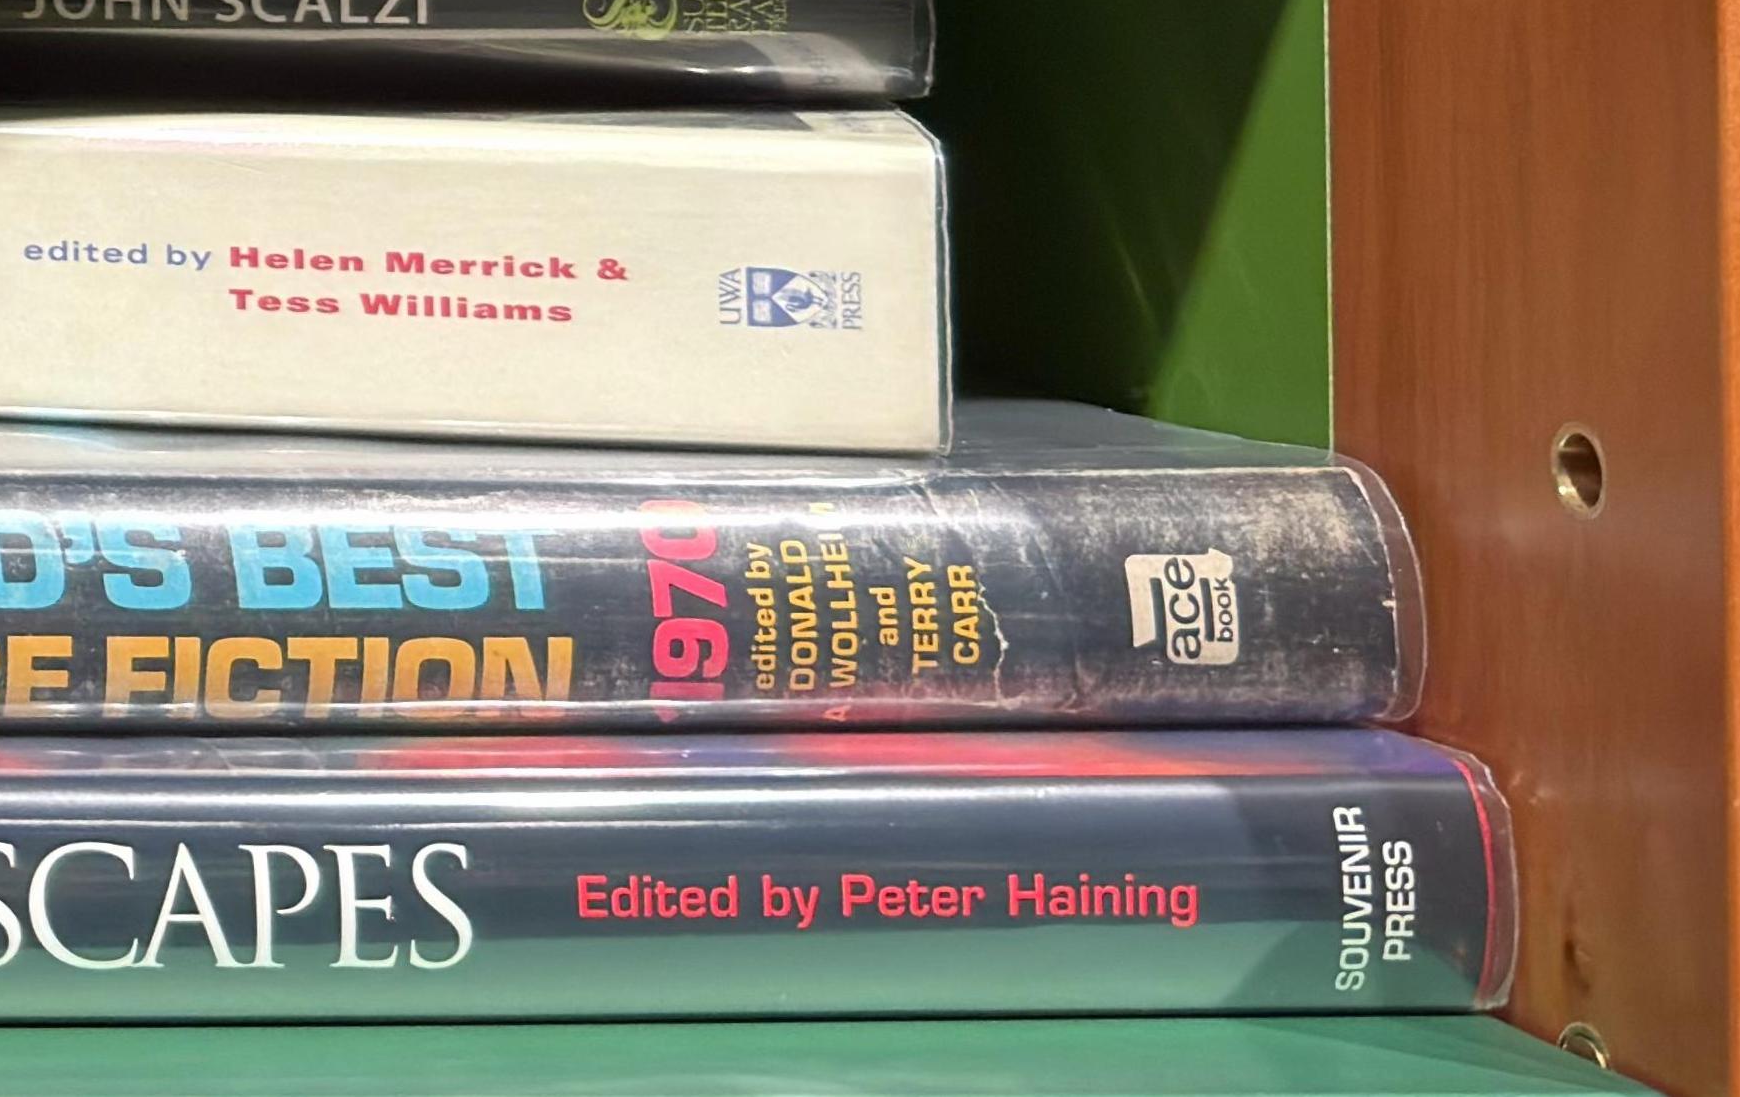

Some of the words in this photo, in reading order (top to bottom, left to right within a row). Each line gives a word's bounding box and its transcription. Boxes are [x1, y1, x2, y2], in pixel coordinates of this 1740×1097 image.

[23, 238, 148, 266] edited
[165, 242, 212, 272] by
[229, 245, 365, 274] Helen
[385, 251, 576, 281] Merrick
[597, 257, 628, 283] &
[229, 288, 339, 315] Tess
[360, 292, 573, 323] Williams
[719, 268, 741, 325] UWA
[842, 272, 862, 329] PRESS
[228, 515, 555, 613] BEST
[745, 542, 773, 579] by
[641, 500, 728, 723] 1970
[747, 588, 776, 690] edited
[780, 540, 818, 691] DONALD
[869, 587, 898, 646] and
[904, 557, 939, 675] TERRY
[947, 564, 980, 664] CARR
[1164, 557, 1201, 659] ace
[1213, 577, 1233, 642] book
[104, 636, 573, 720] FICTION
[579, 874, 738, 919] Edited
[761, 873, 816, 929] by
[840, 873, 985, 919] Peter
[1007, 875, 1199, 925] Haining
[1334, 804, 1369, 992] SOUVENIR
[1382, 839, 1413, 962] PRESS
